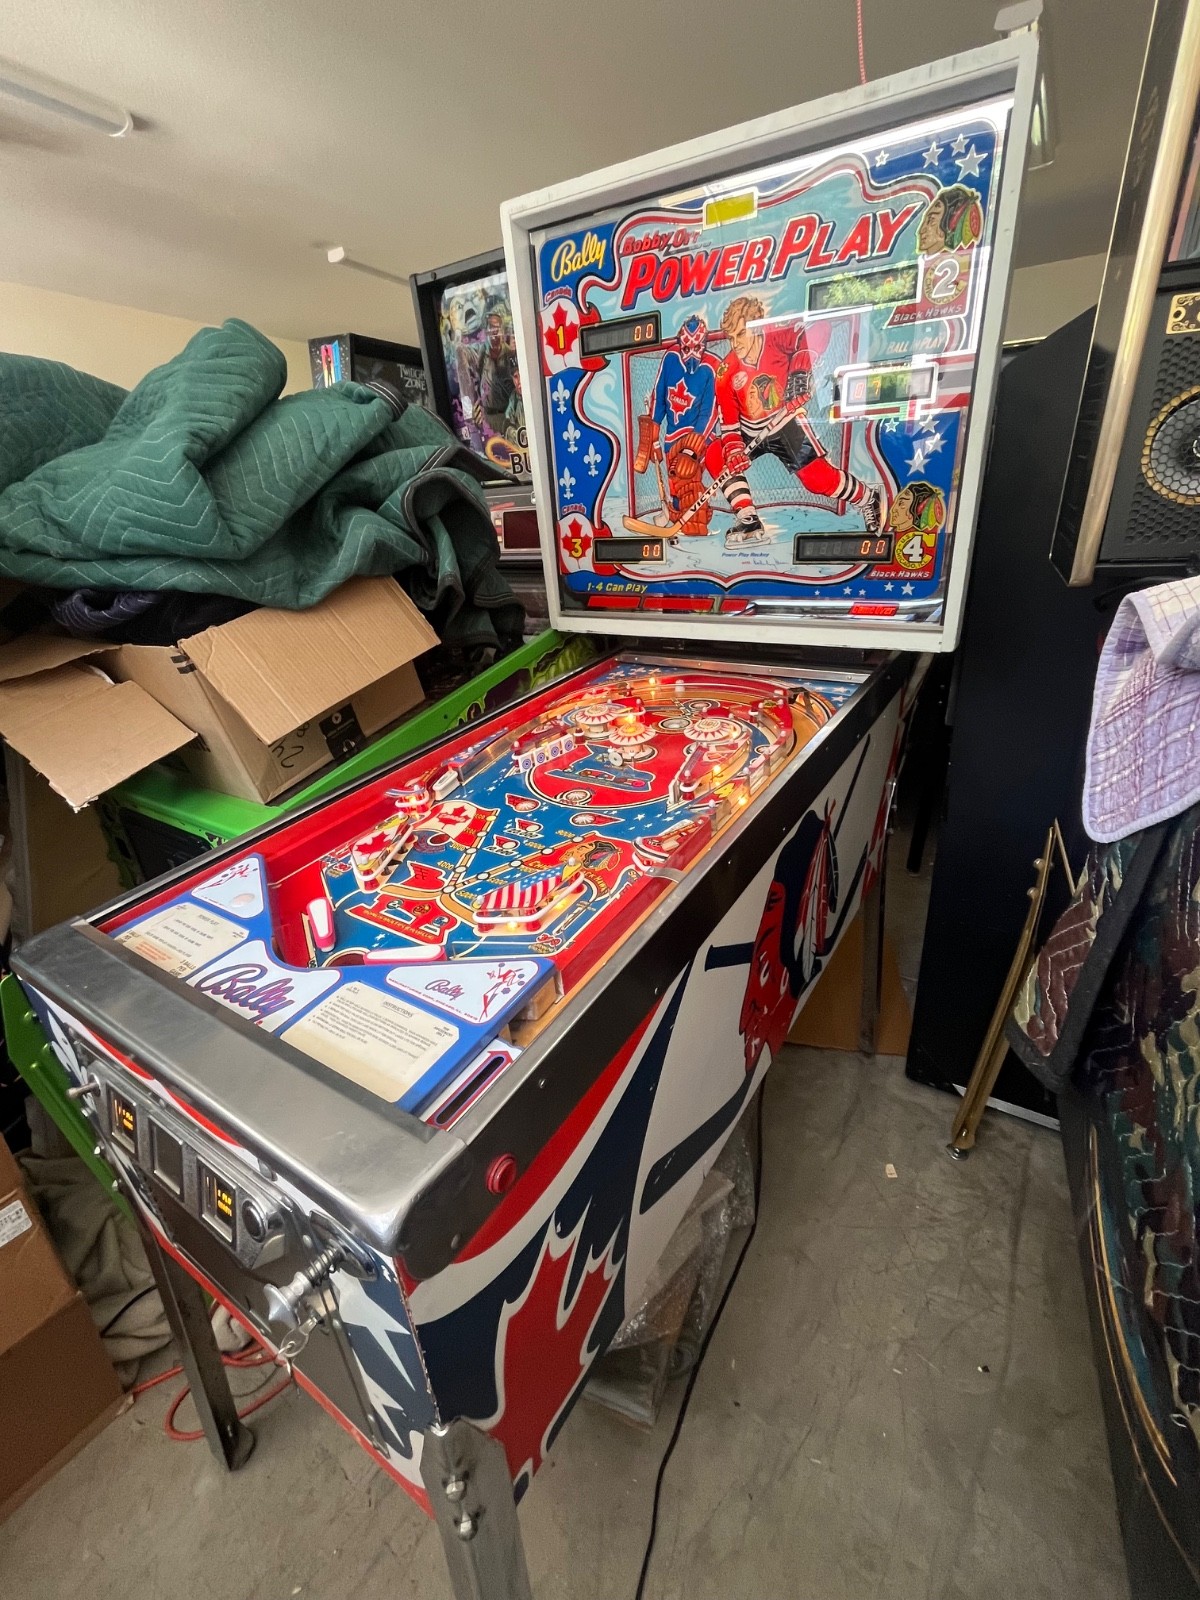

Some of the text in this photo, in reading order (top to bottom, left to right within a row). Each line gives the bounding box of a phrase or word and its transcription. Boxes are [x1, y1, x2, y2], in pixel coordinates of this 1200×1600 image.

[622, 228, 702, 256] Bobby Orr
[551, 232, 607, 282] Bally
[932, 259, 959, 298] 2
[556, 326, 565, 349] 1
[571, 538, 582, 558] 3
[642, 544, 661, 558] 00
[903, 535, 923, 563] 4
[605, 582, 624, 592] Can
[625, 582, 648, 594] Play
[194, 963, 295, 1023] Bally
[425, 980, 465, 1001] Bally
